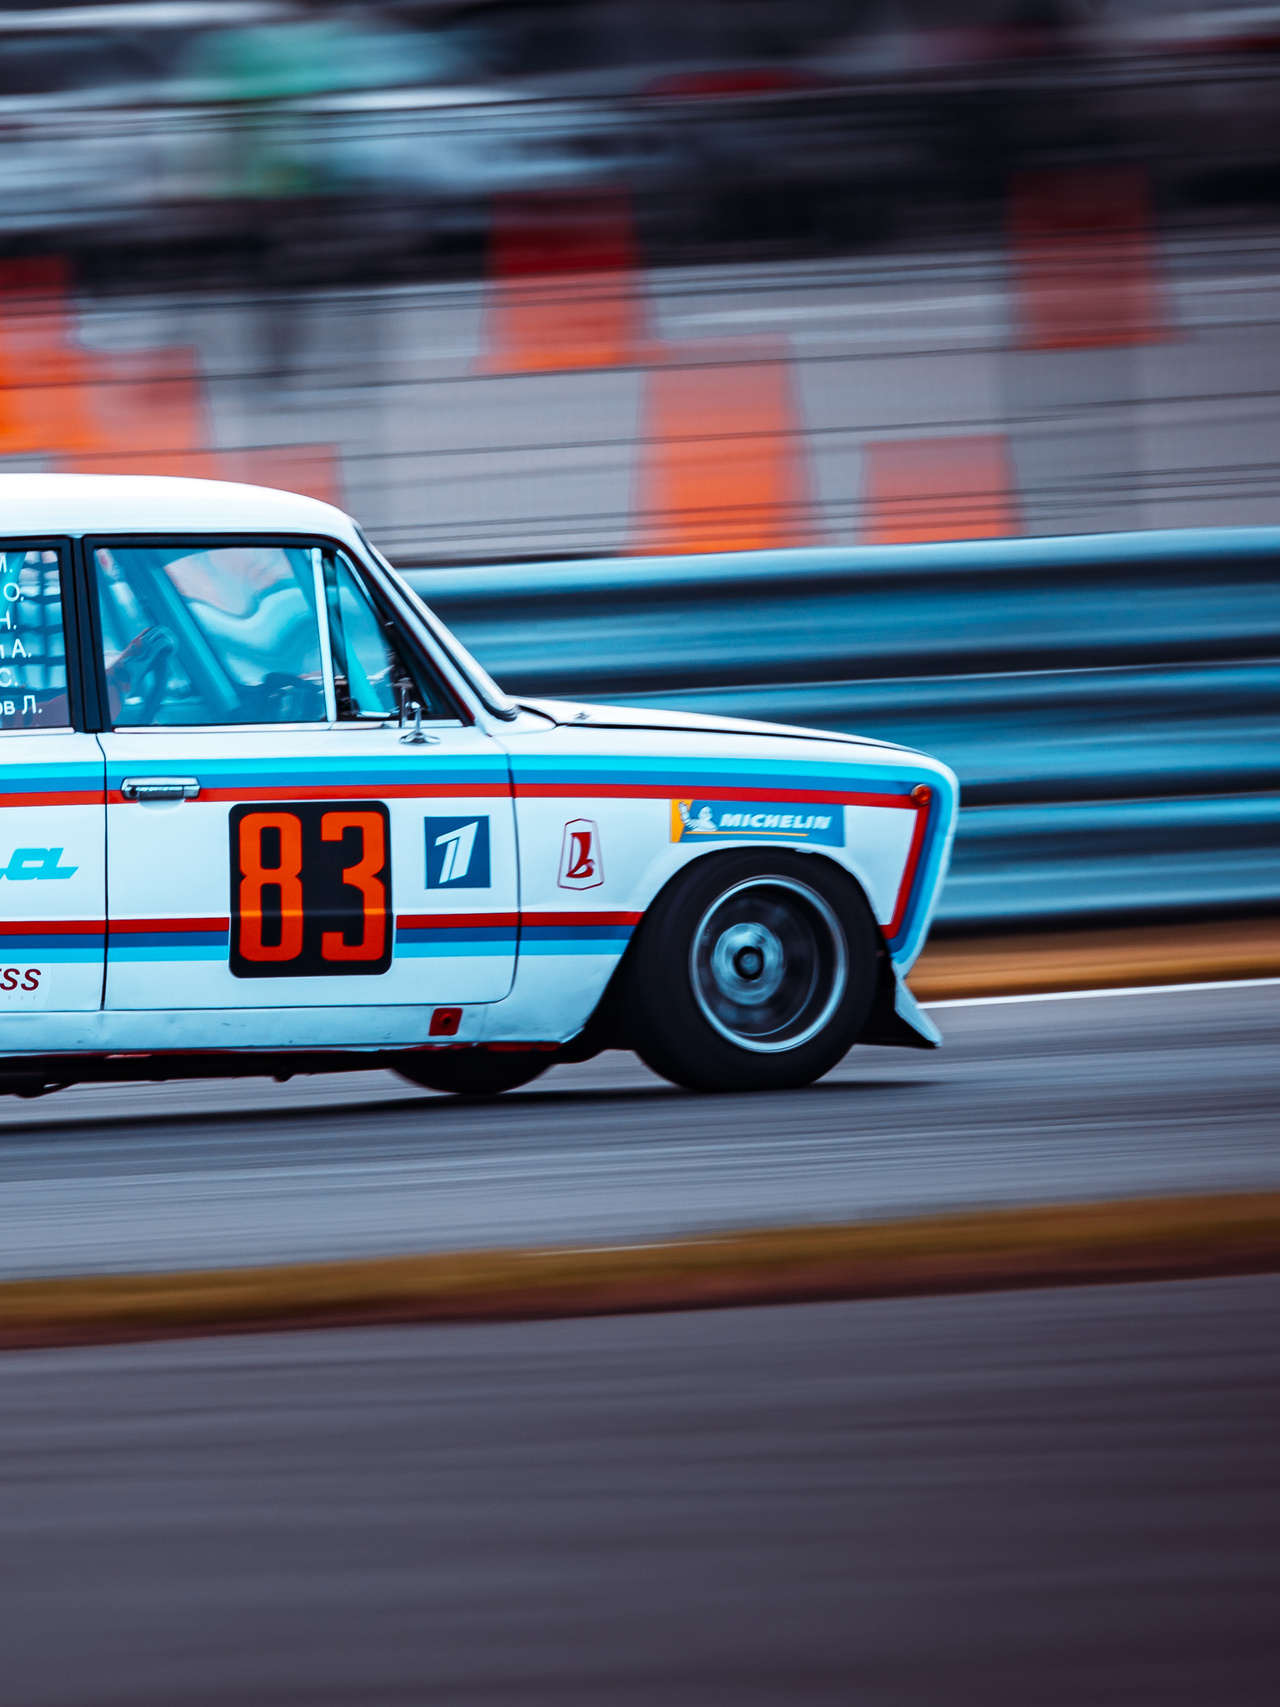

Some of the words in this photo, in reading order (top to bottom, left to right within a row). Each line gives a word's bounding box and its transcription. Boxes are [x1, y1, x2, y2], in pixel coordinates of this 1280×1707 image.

[3, 582, 25, 602] О.
[11, 639, 32, 659] А.
[22, 695, 43, 715] Л.
[721, 813, 833, 830] MICHELIN
[238, 811, 387, 961] 83
